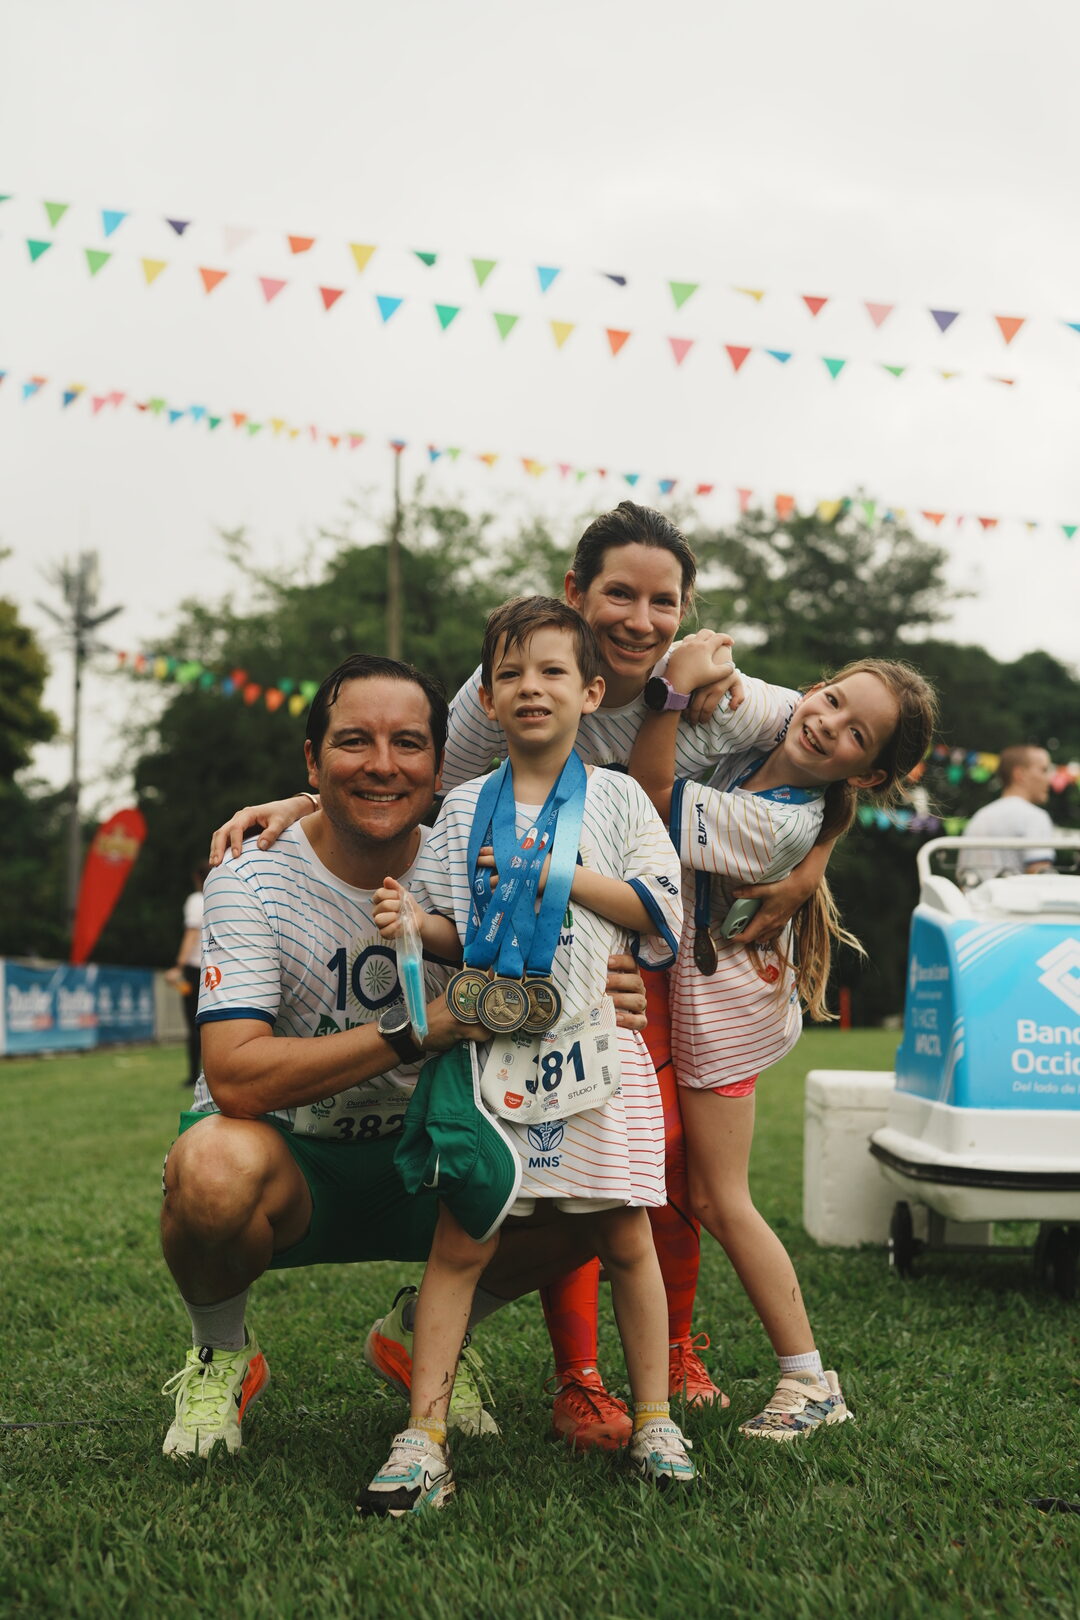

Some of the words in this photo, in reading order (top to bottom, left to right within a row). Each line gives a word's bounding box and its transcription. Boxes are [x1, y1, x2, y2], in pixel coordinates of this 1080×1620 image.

[485, 912, 501, 941] Duraflex
[327, 946, 405, 1010] 10
[507, 991, 519, 999] Be
[567, 1085, 592, 1100] STUDIO
